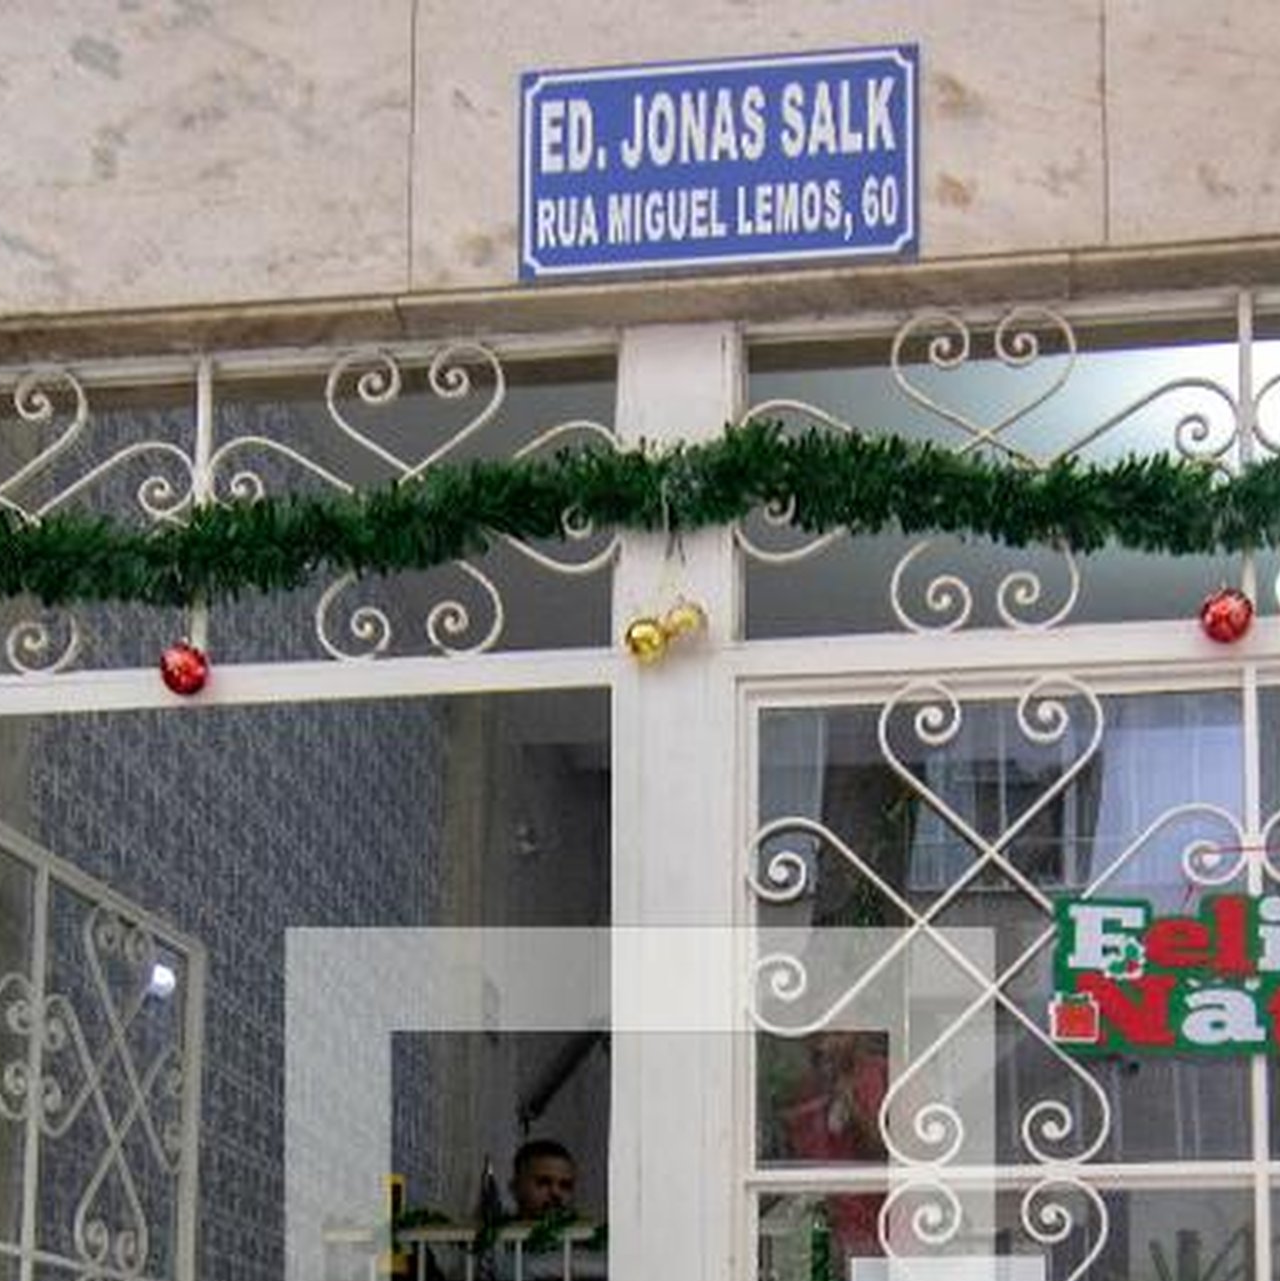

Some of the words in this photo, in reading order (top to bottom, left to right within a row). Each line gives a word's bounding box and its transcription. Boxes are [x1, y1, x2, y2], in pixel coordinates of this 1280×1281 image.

[540, 99, 606, 173] ED.
[622, 86, 766, 168] JONAS
[781, 76, 896, 158] SALK
[537, 196, 599, 248] RUA
[607, 188, 726, 245] MIGUEL
[737, 179, 853, 241] LEMOS,
[862, 176, 898, 226] 60
